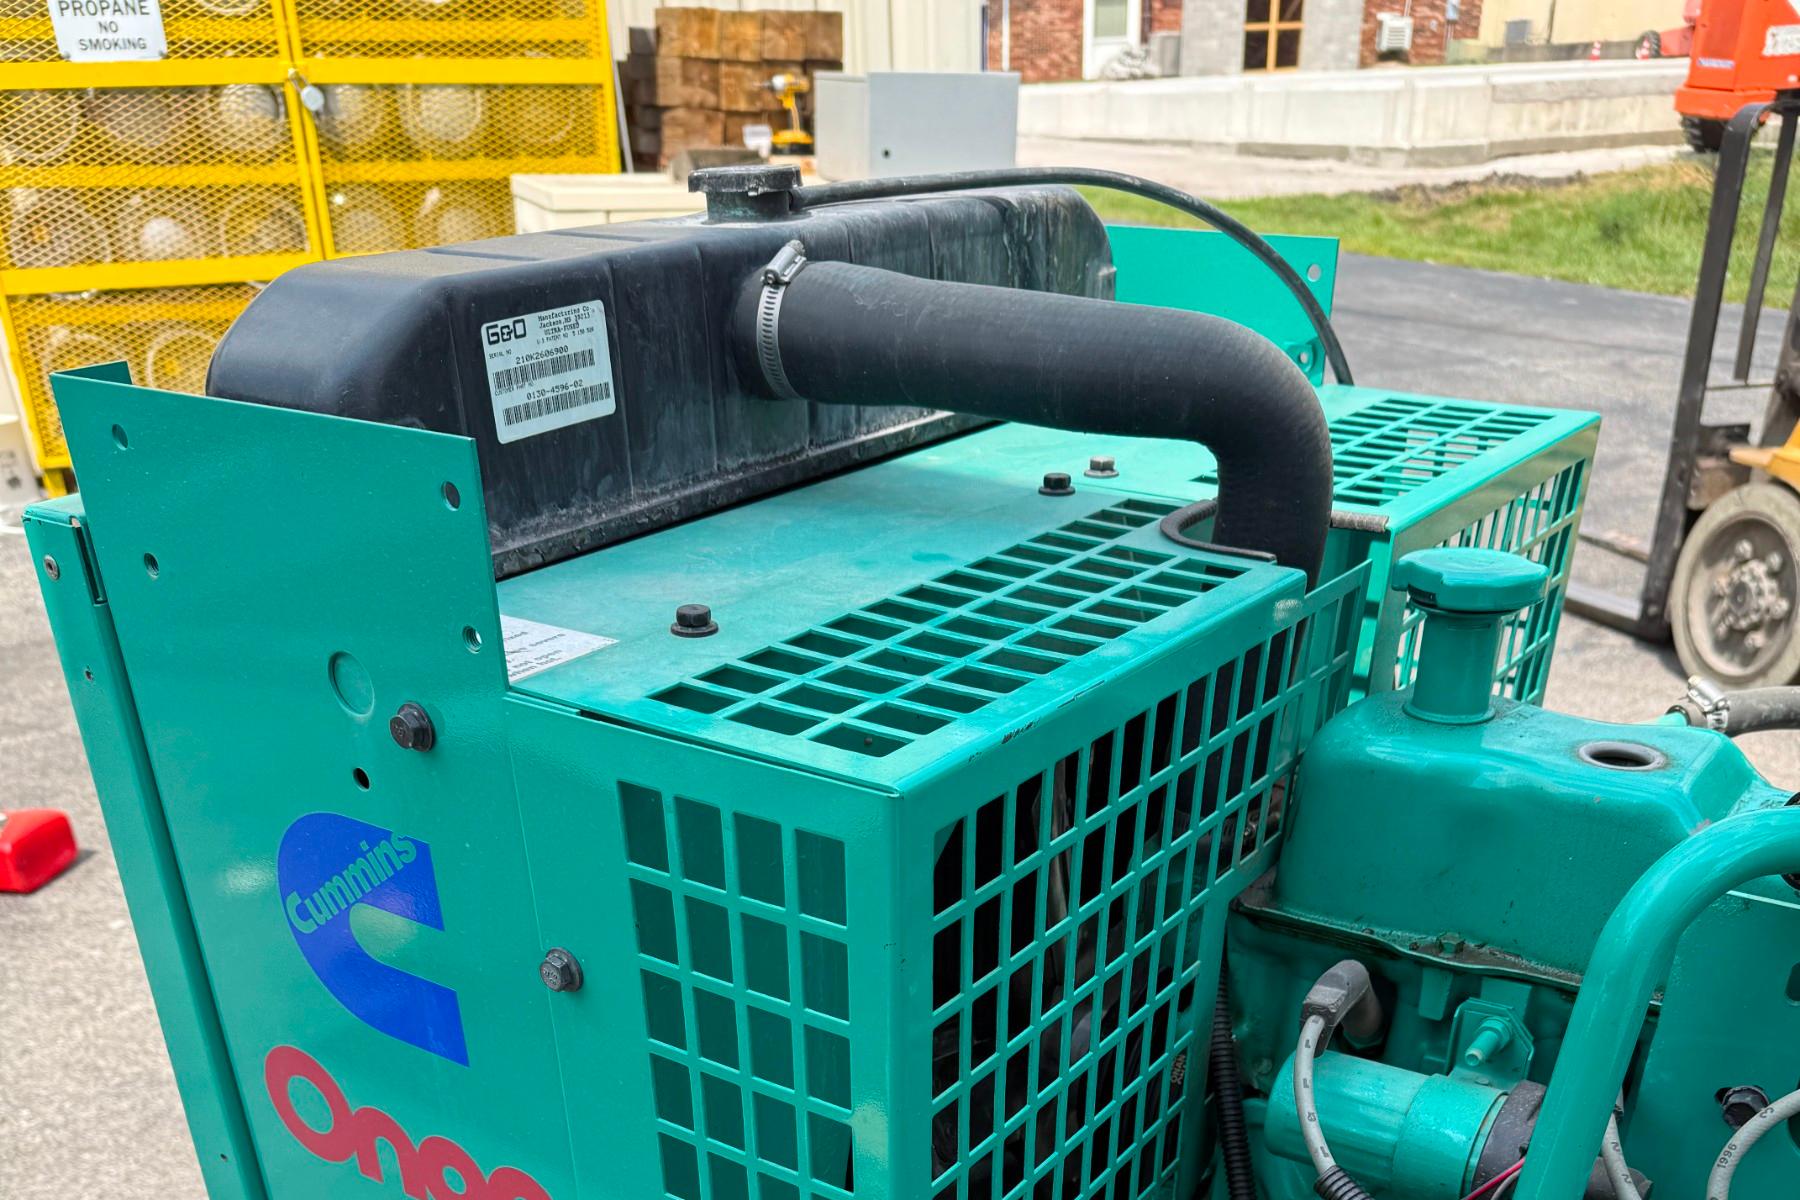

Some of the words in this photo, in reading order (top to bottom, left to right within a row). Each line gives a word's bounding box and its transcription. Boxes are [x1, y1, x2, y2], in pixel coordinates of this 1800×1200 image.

[57, 0, 151, 16] PROPANE
[98, 21, 119, 33] NO
[79, 38, 147, 51] SMOKING
[286, 832, 418, 934] Cummins
[1716, 1143, 1737, 1169] 1996
